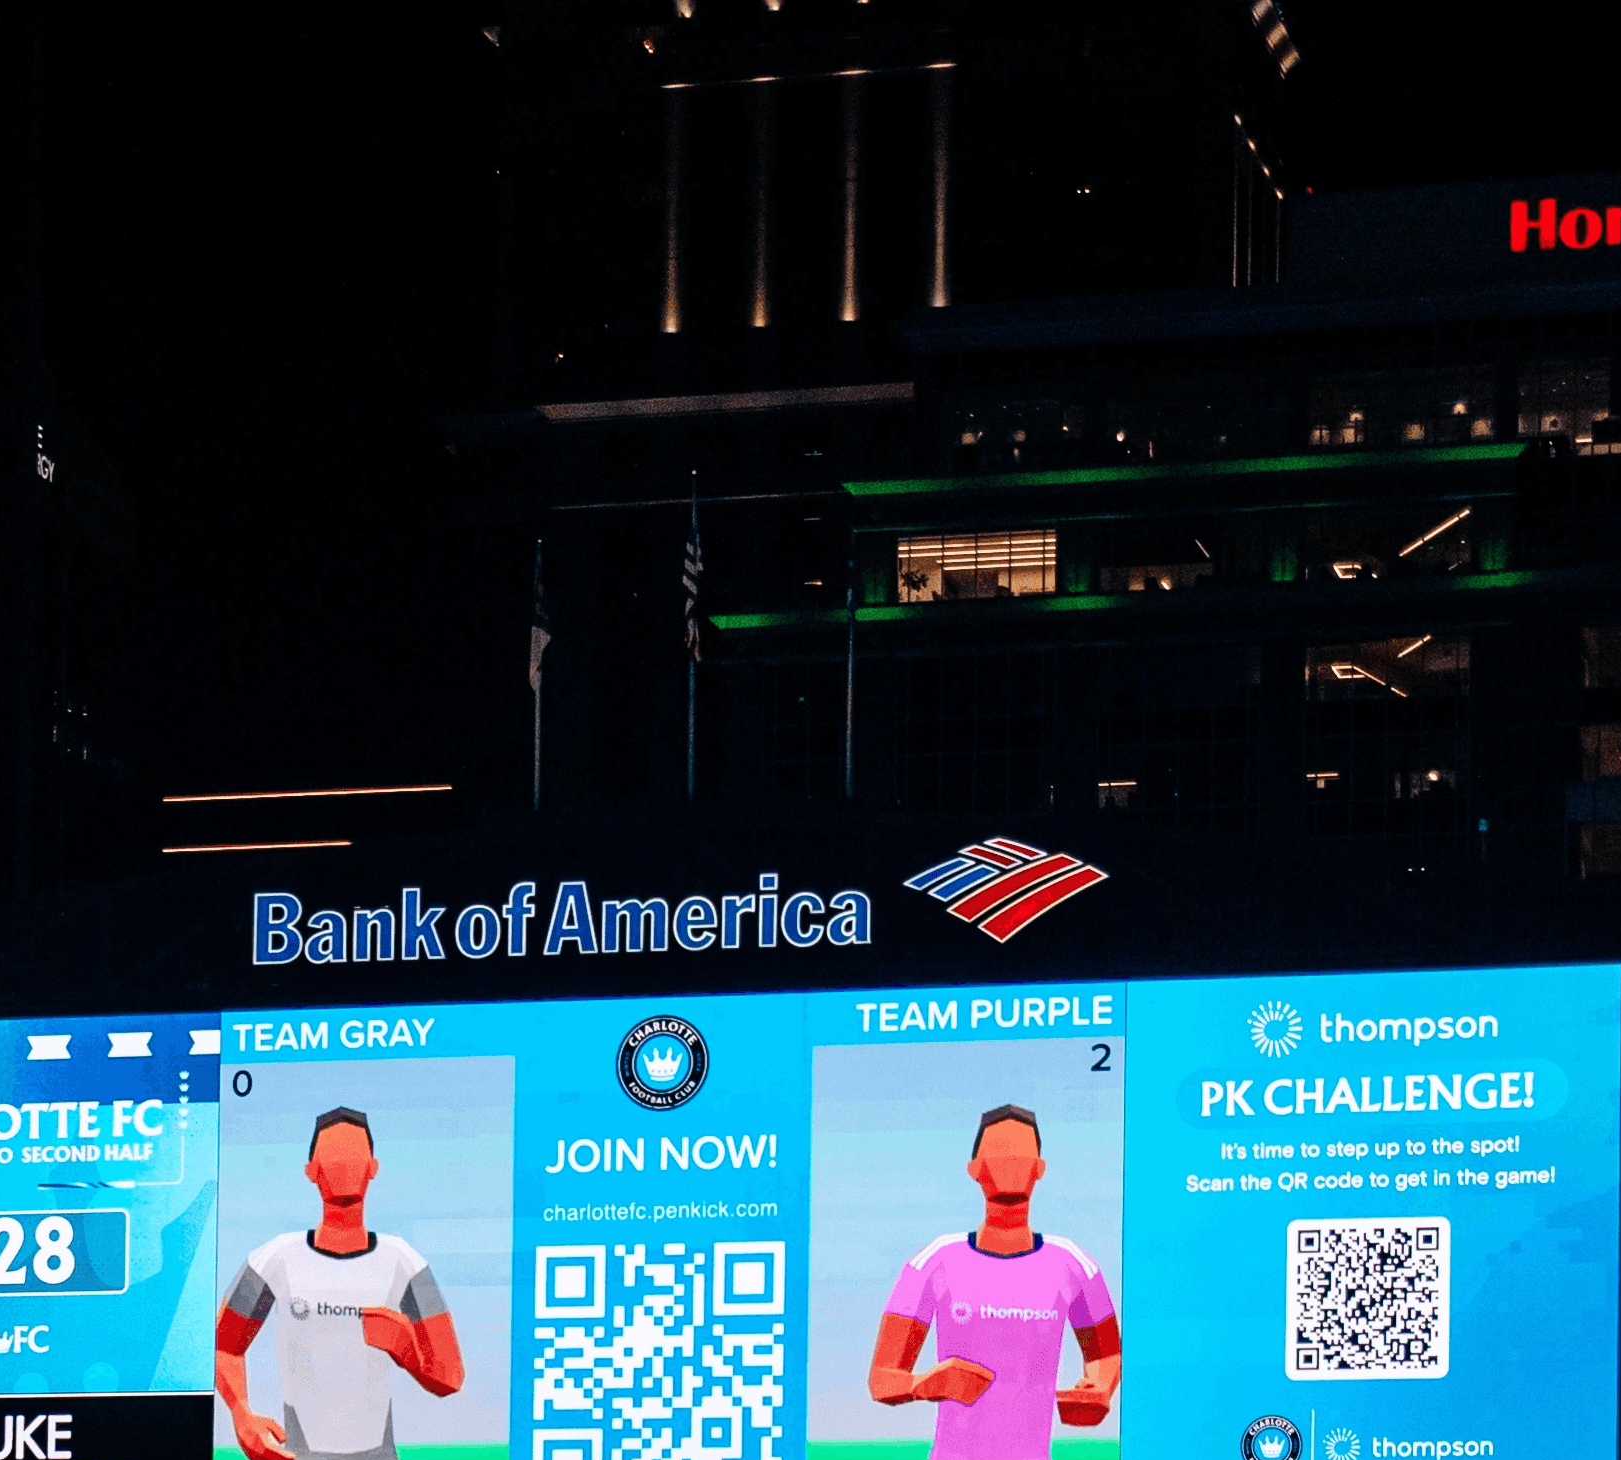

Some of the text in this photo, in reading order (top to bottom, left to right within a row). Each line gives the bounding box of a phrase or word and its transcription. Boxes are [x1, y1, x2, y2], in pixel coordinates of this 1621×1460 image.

[253, 874, 870, 964] Bank of America
[857, 996, 1111, 1031] TEAM PURPLE
[233, 1019, 433, 1050] TEAM GRAY
[626, 1018, 699, 1048] CHARLOTTE
[1321, 1014, 1497, 1046] thompson
[1091, 1044, 1111, 1072] 2
[232, 1070, 253, 1097] 0
[628, 1080, 696, 1105] FOOTBALL CLUB
[1202, 1072, 1533, 1116] PK CHALLENGE!
[113, 1100, 163, 1136] FC
[23, 1146, 100, 1162] SECOND
[105, 1143, 152, 1160] HALF
[546, 1135, 776, 1172] JOIN NOW!
[1222, 1136, 1519, 1159] It's time to step up to the spot!
[1187, 1167, 1555, 1192] Scan the QR code to get in the game!
[543, 1201, 778, 1222] charlottefc.penkick.com
[978, 1303, 1059, 1324] thompson
[1248, 1417, 1294, 1436] CHARLOTTE
[1373, 1438, 1493, 1460] thompson
